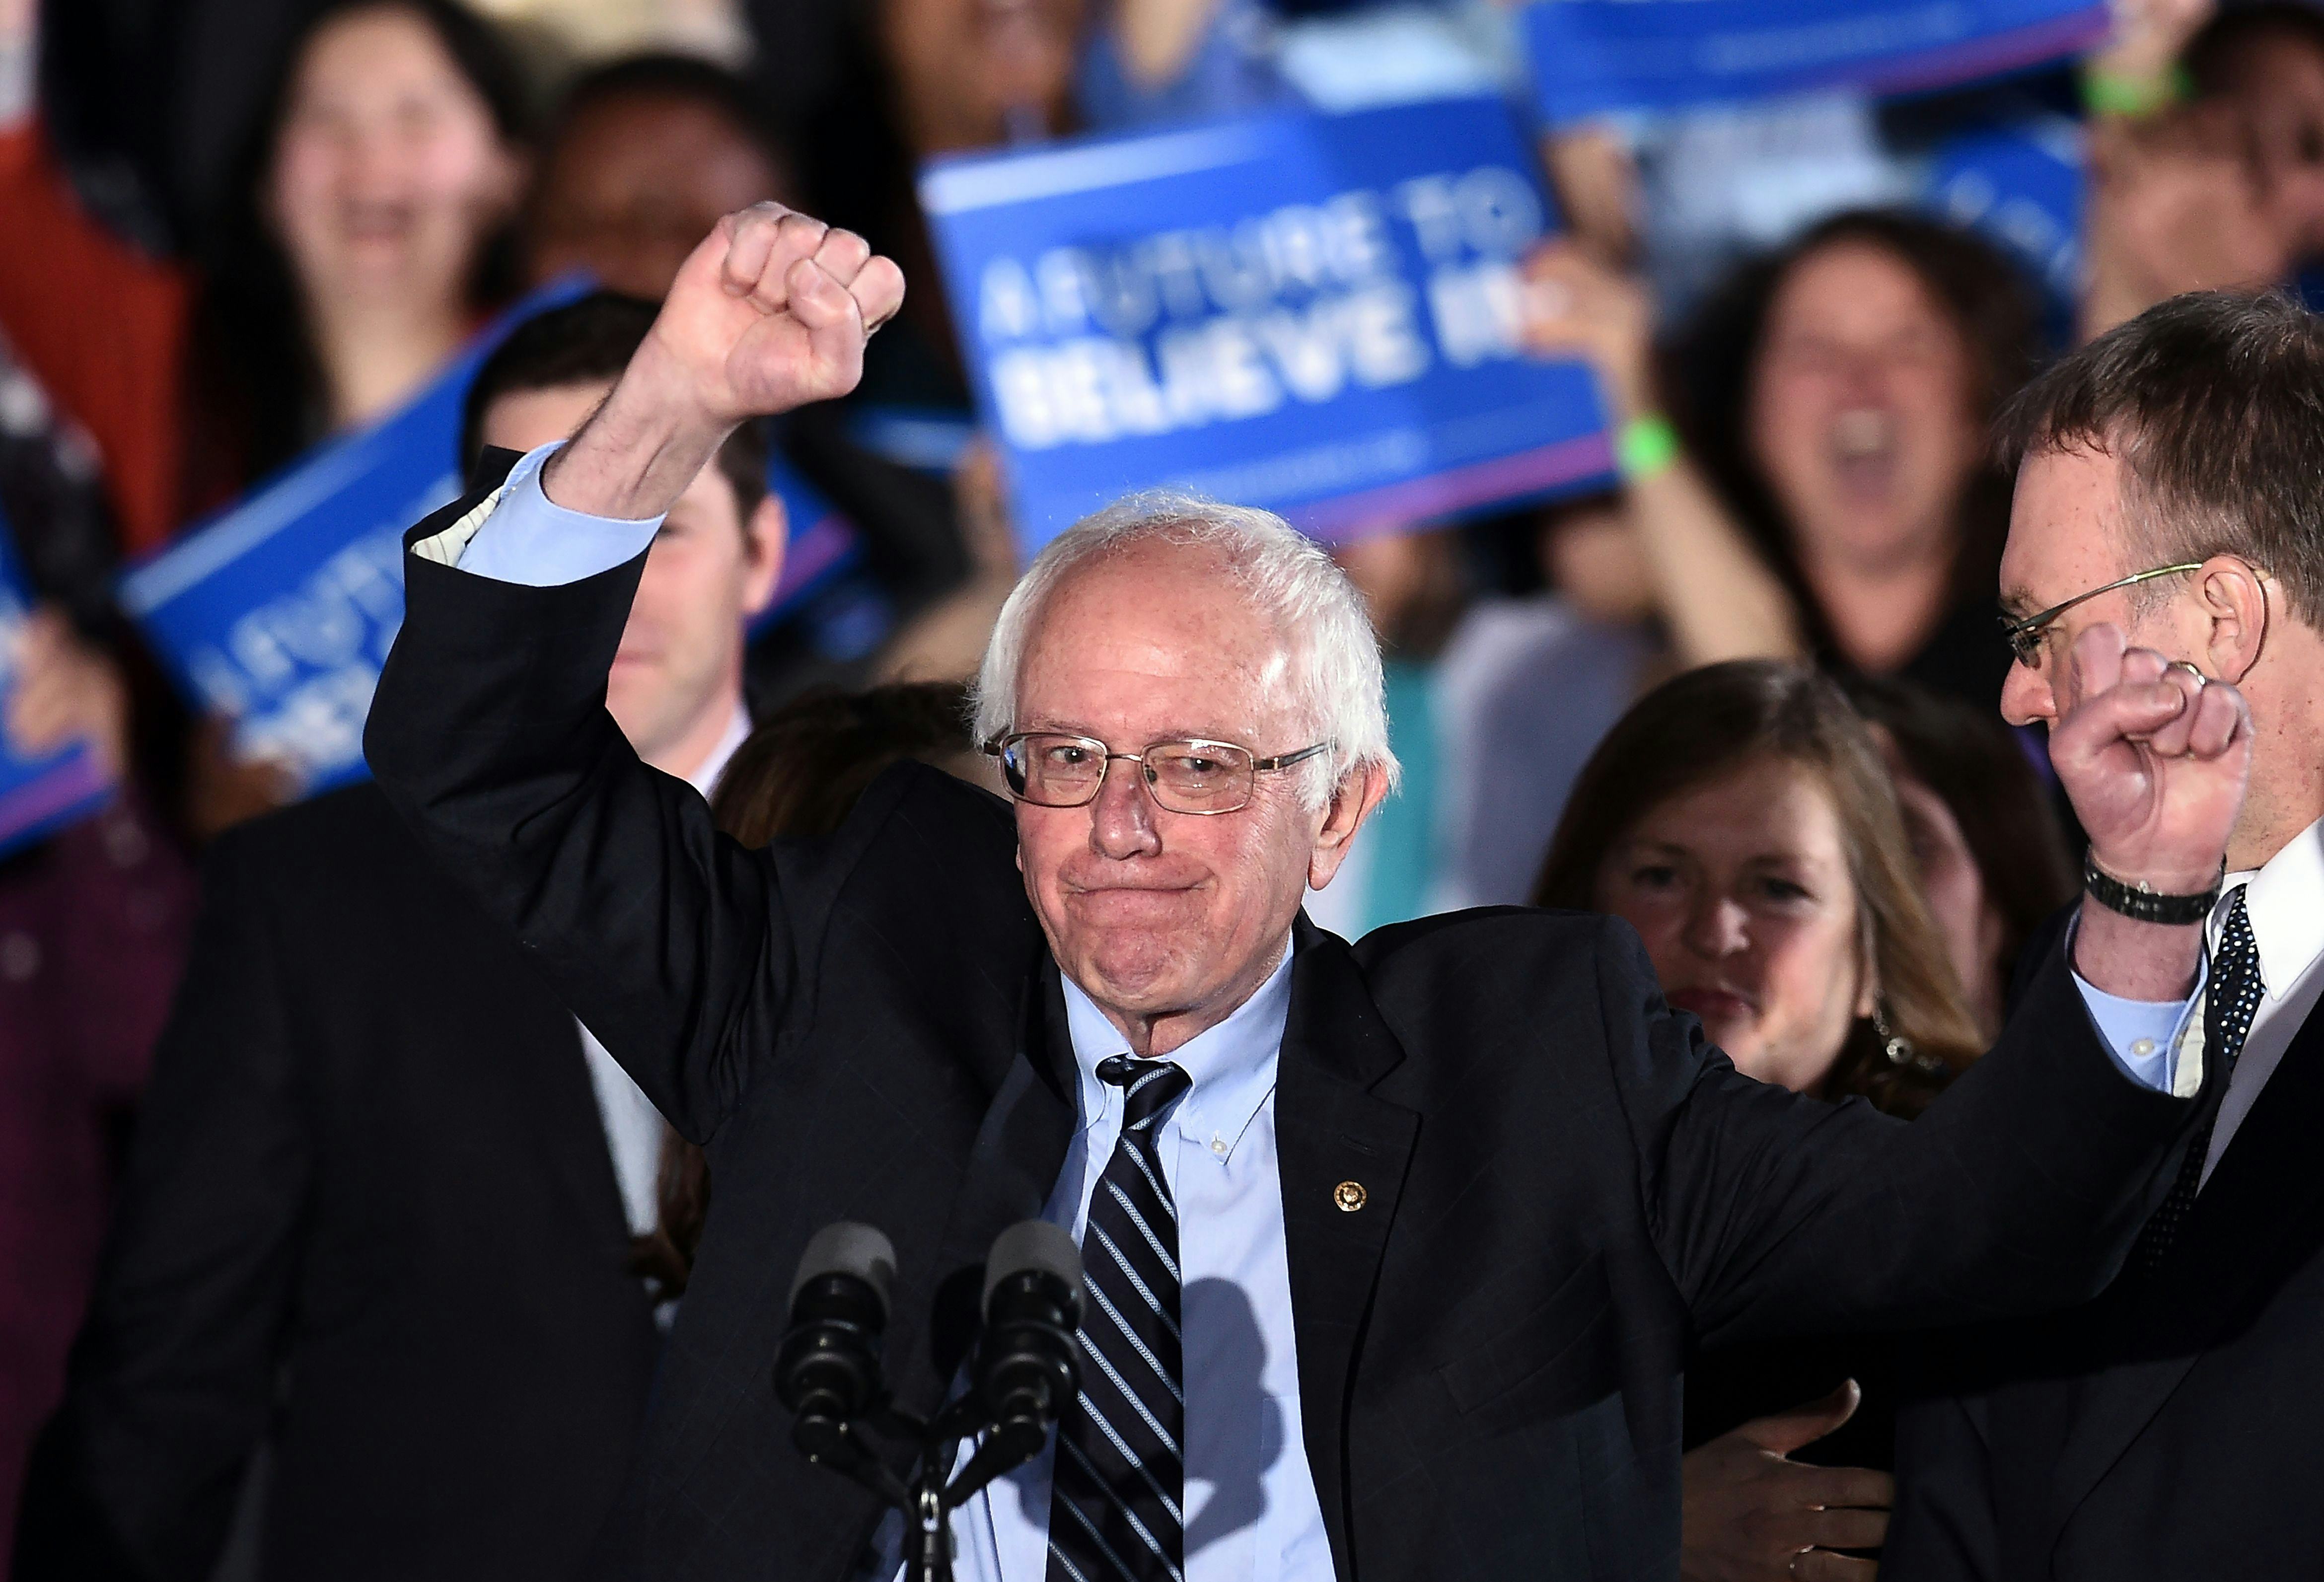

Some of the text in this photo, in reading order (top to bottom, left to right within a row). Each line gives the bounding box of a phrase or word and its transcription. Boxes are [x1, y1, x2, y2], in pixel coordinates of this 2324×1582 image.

[979, 166, 1543, 342] A FUTURE TO
[994, 283, 1431, 451] BELIEVE
